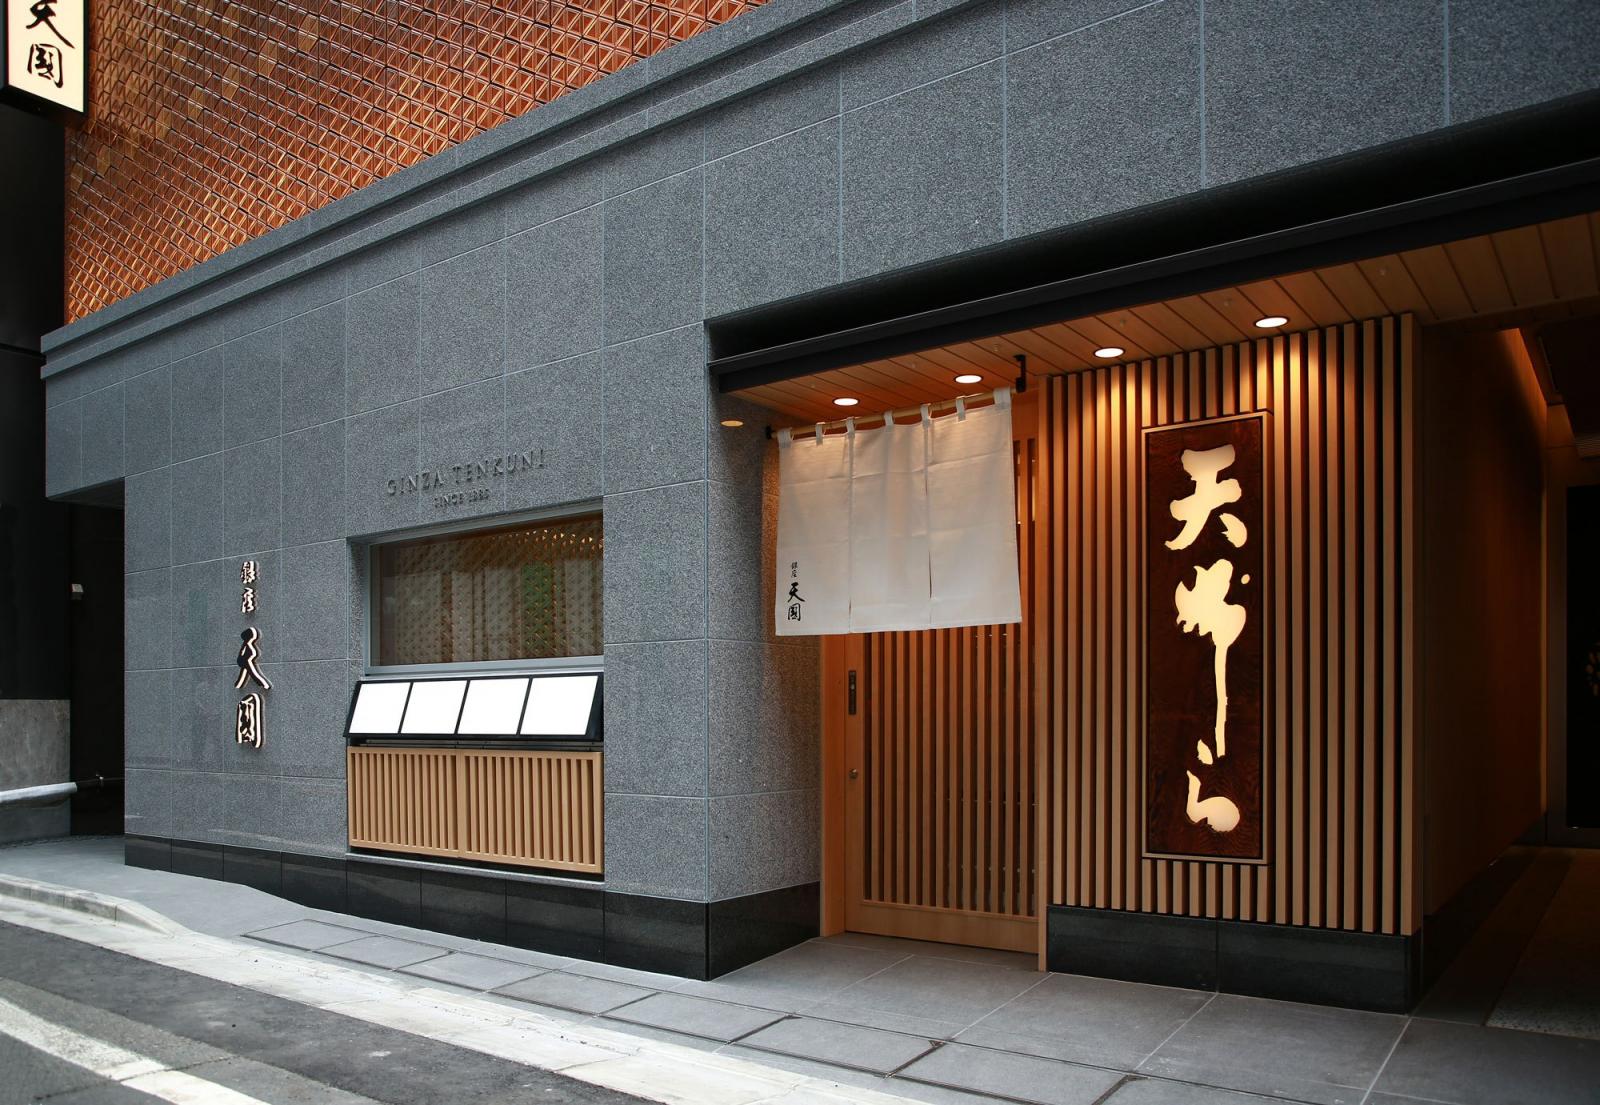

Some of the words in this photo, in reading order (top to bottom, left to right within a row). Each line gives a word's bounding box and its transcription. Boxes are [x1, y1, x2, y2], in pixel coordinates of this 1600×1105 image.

[387, 470, 444, 496] GINZA
[452, 449, 545, 484] TENKUNI
[433, 491, 464, 508] SINCE
